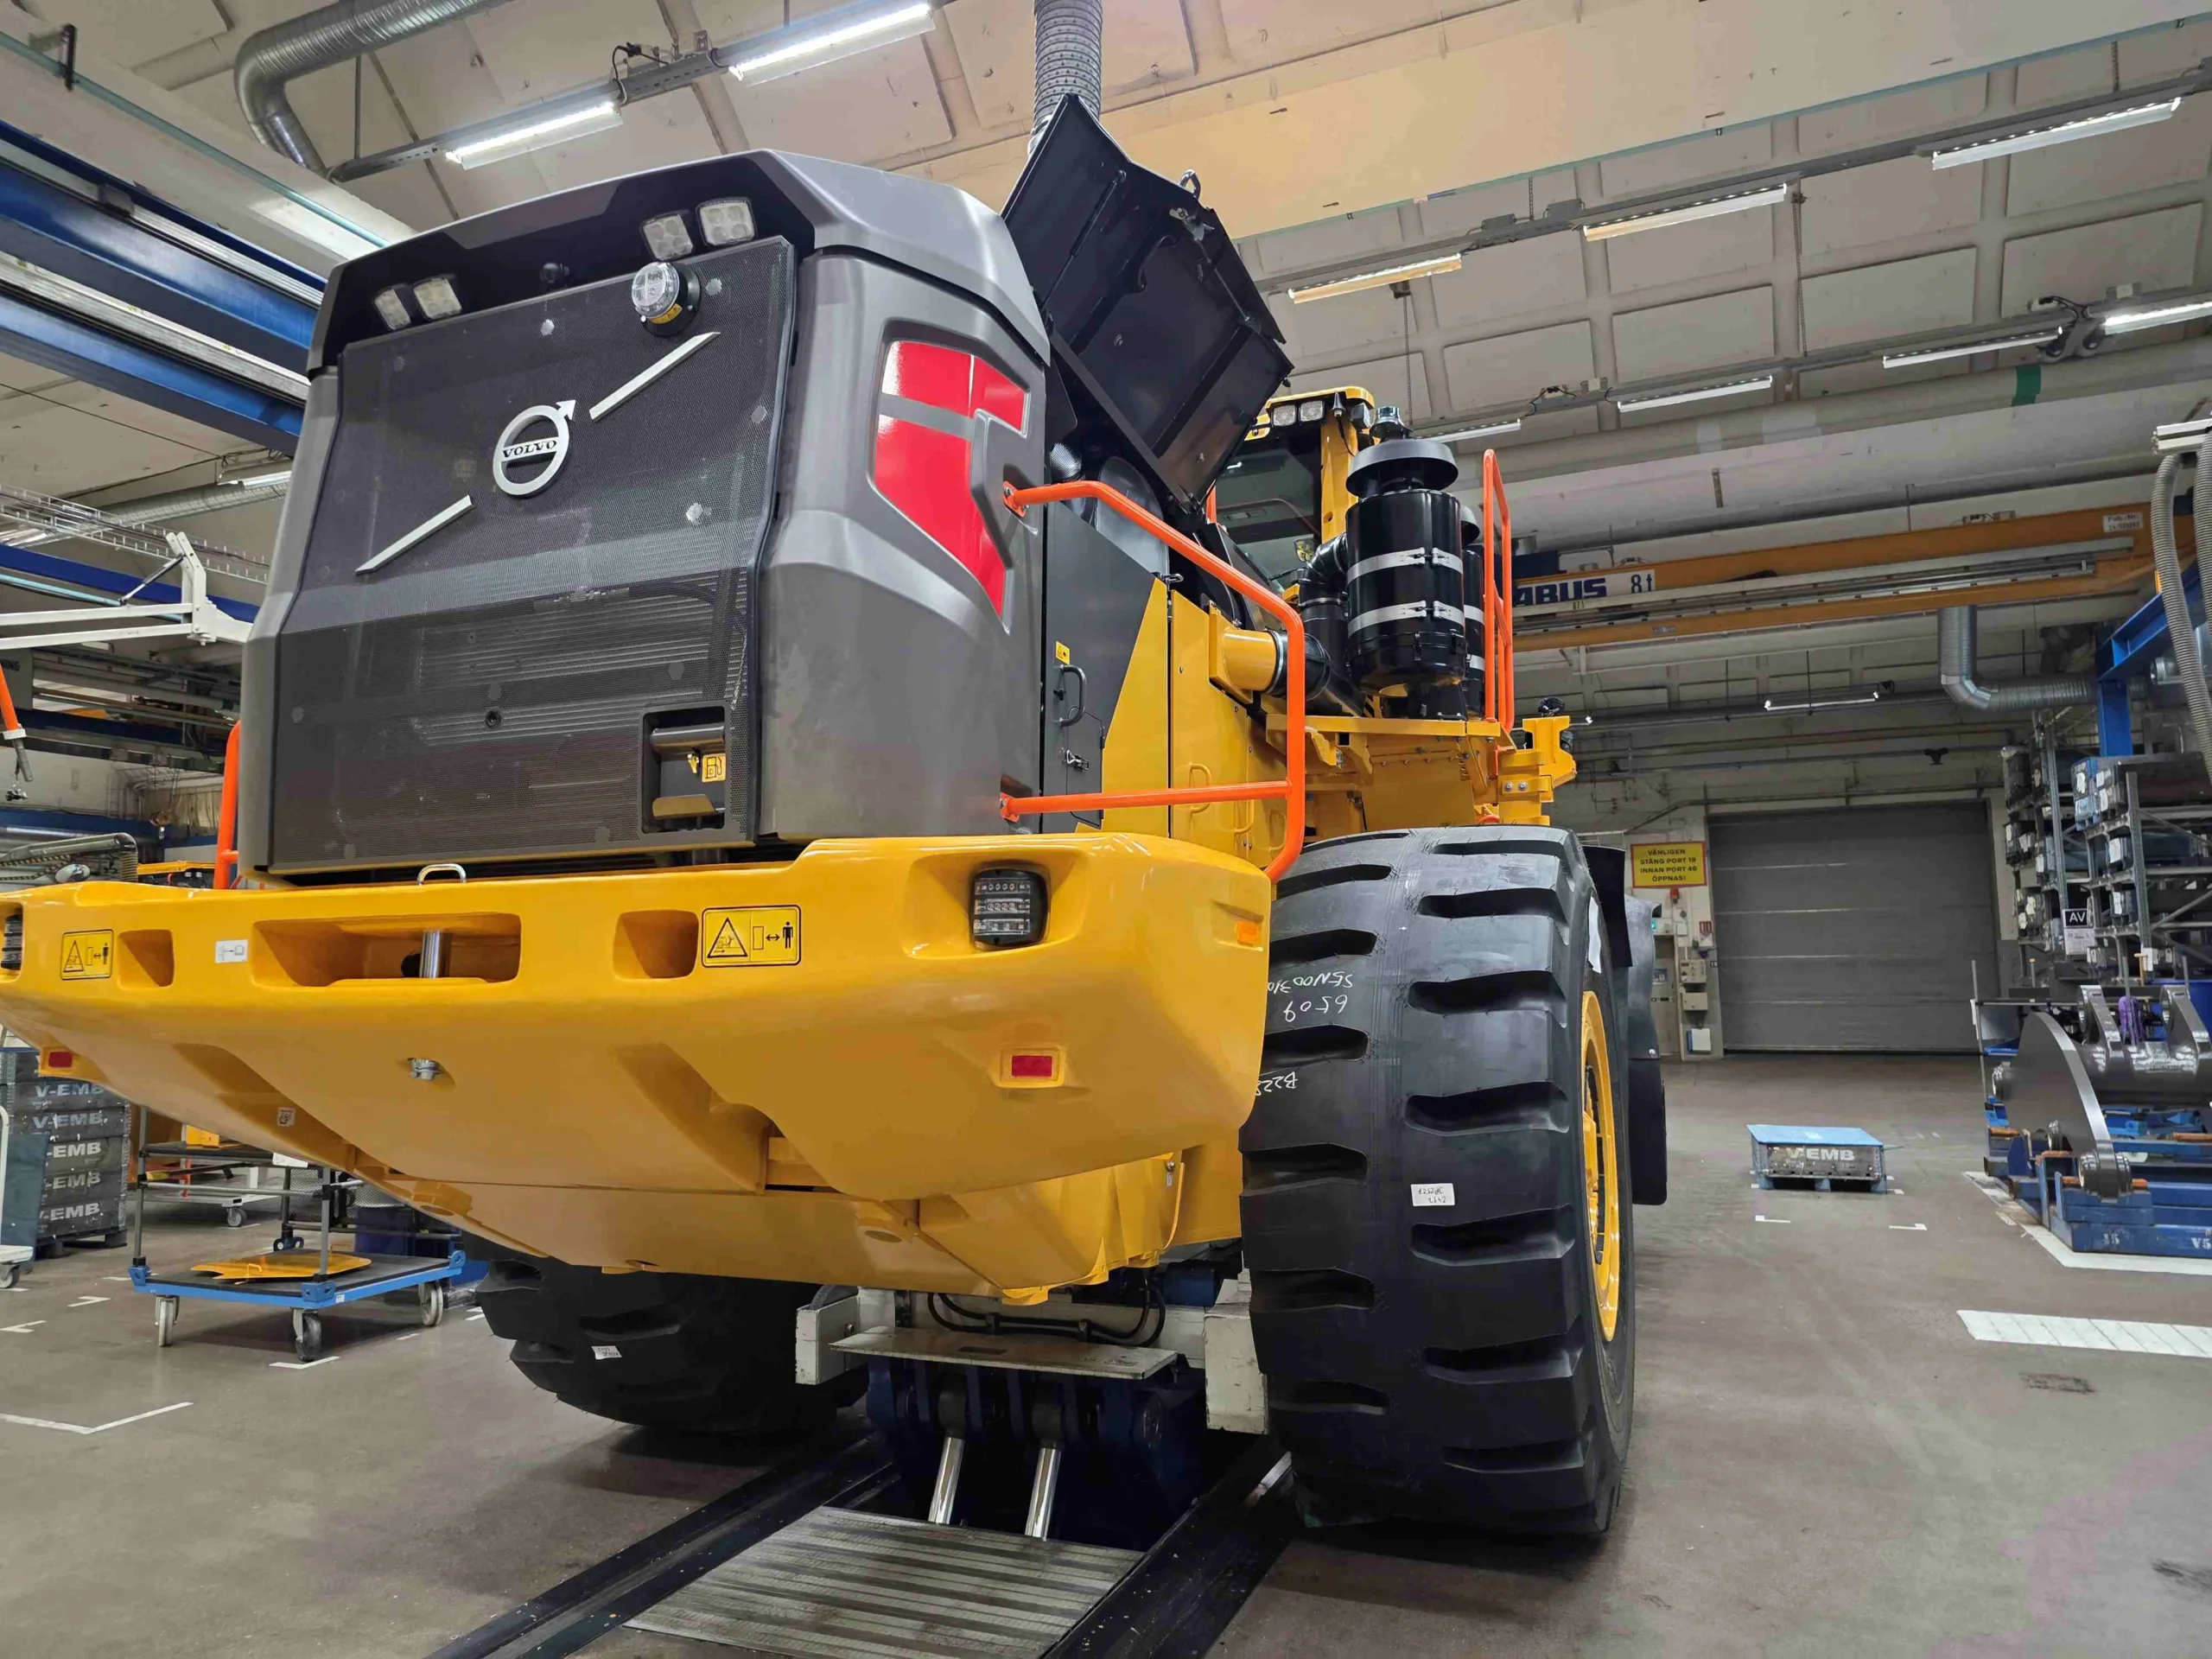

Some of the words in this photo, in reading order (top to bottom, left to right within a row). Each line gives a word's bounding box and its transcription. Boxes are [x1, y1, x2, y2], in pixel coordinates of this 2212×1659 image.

[502, 440, 557, 458] VOLVO
[1513, 577, 1607, 607] ABUS
[2069, 912, 2086, 923] AV
[33, 1112, 103, 1128] V-EMB
[47, 1141, 101, 1158] -EMB
[44, 1172, 101, 1190] -EMB
